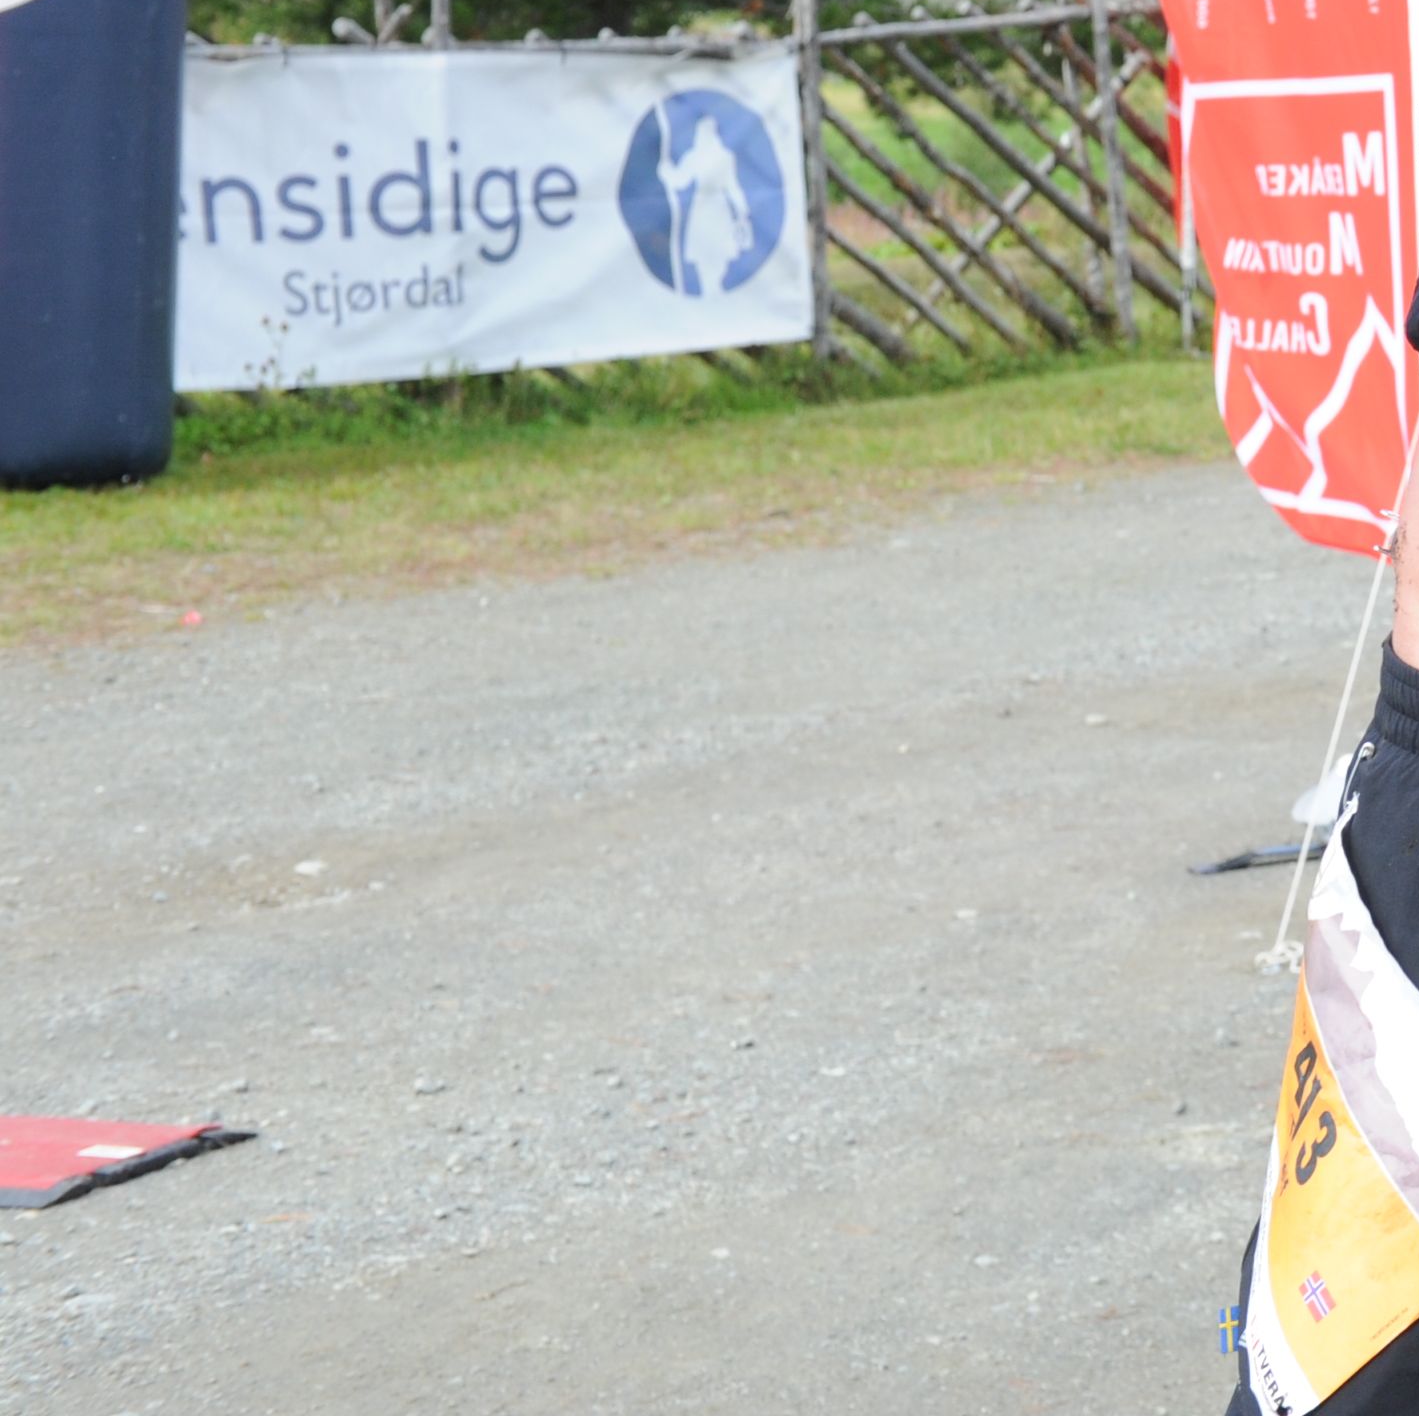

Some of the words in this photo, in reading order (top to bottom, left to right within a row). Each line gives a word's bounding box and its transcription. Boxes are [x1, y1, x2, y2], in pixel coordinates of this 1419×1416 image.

[178, 137, 578, 262] nsidige
[283, 262, 465, 327] Stjørdal
[1290, 1041, 1337, 1186] 413
